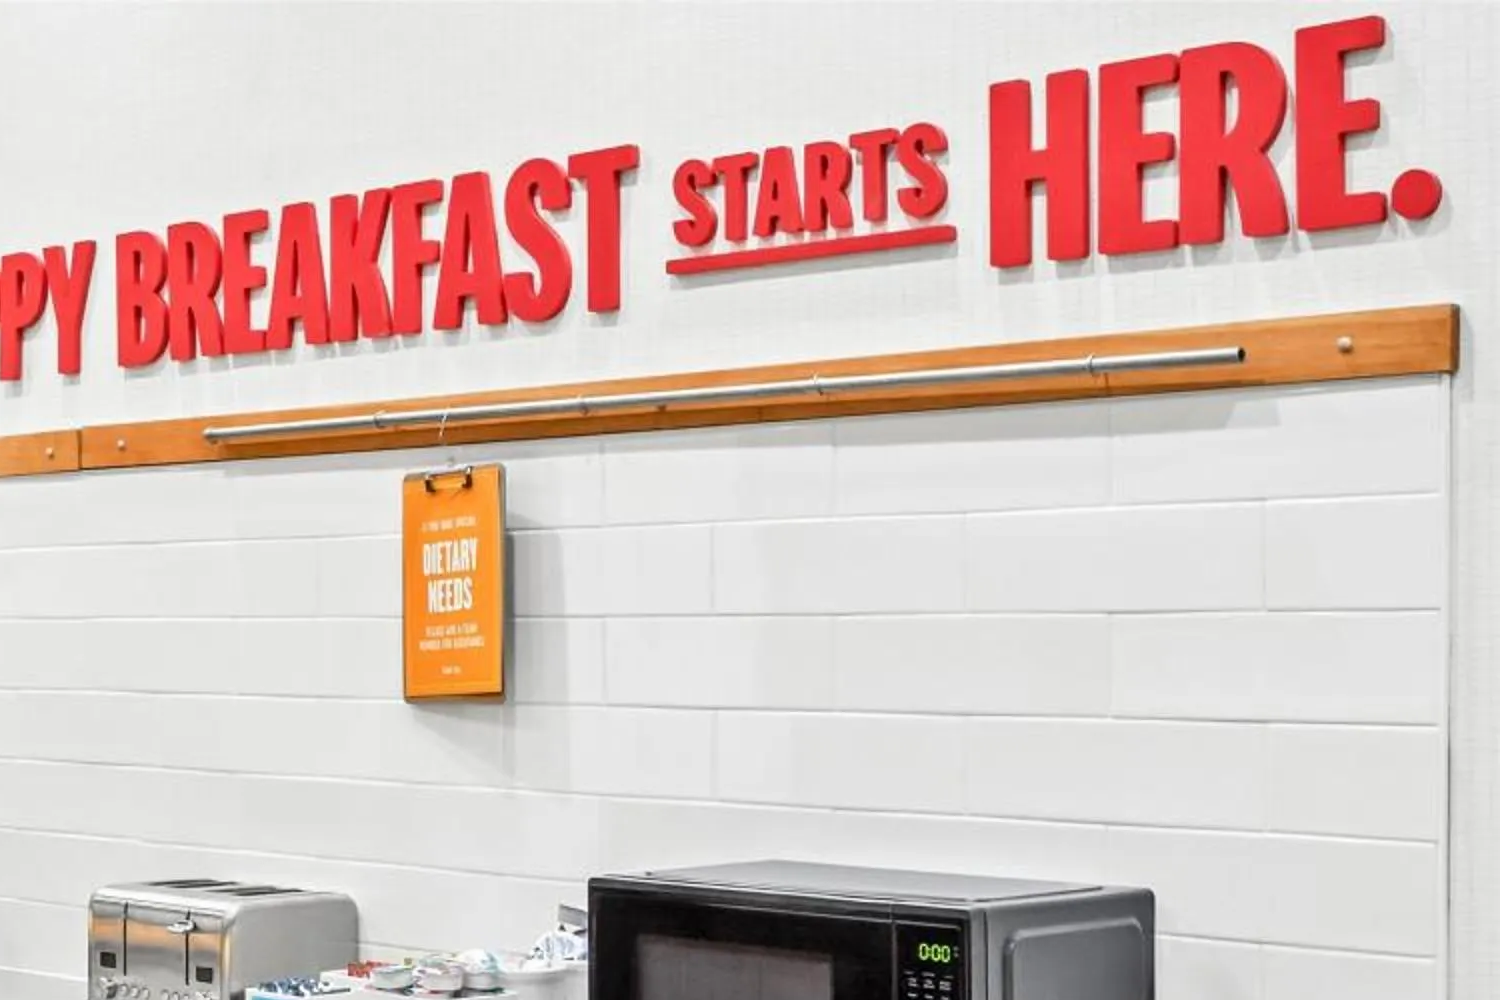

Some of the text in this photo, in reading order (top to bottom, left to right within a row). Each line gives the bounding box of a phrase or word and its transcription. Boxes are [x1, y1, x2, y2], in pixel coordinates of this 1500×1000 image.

[115, 144, 641, 369] BREAKFAST
[672, 122, 949, 248] STARTS
[989, 15, 1443, 269] HERE.
[422, 536, 479, 576] DIETARY
[427, 577, 474, 613] NEEDS
